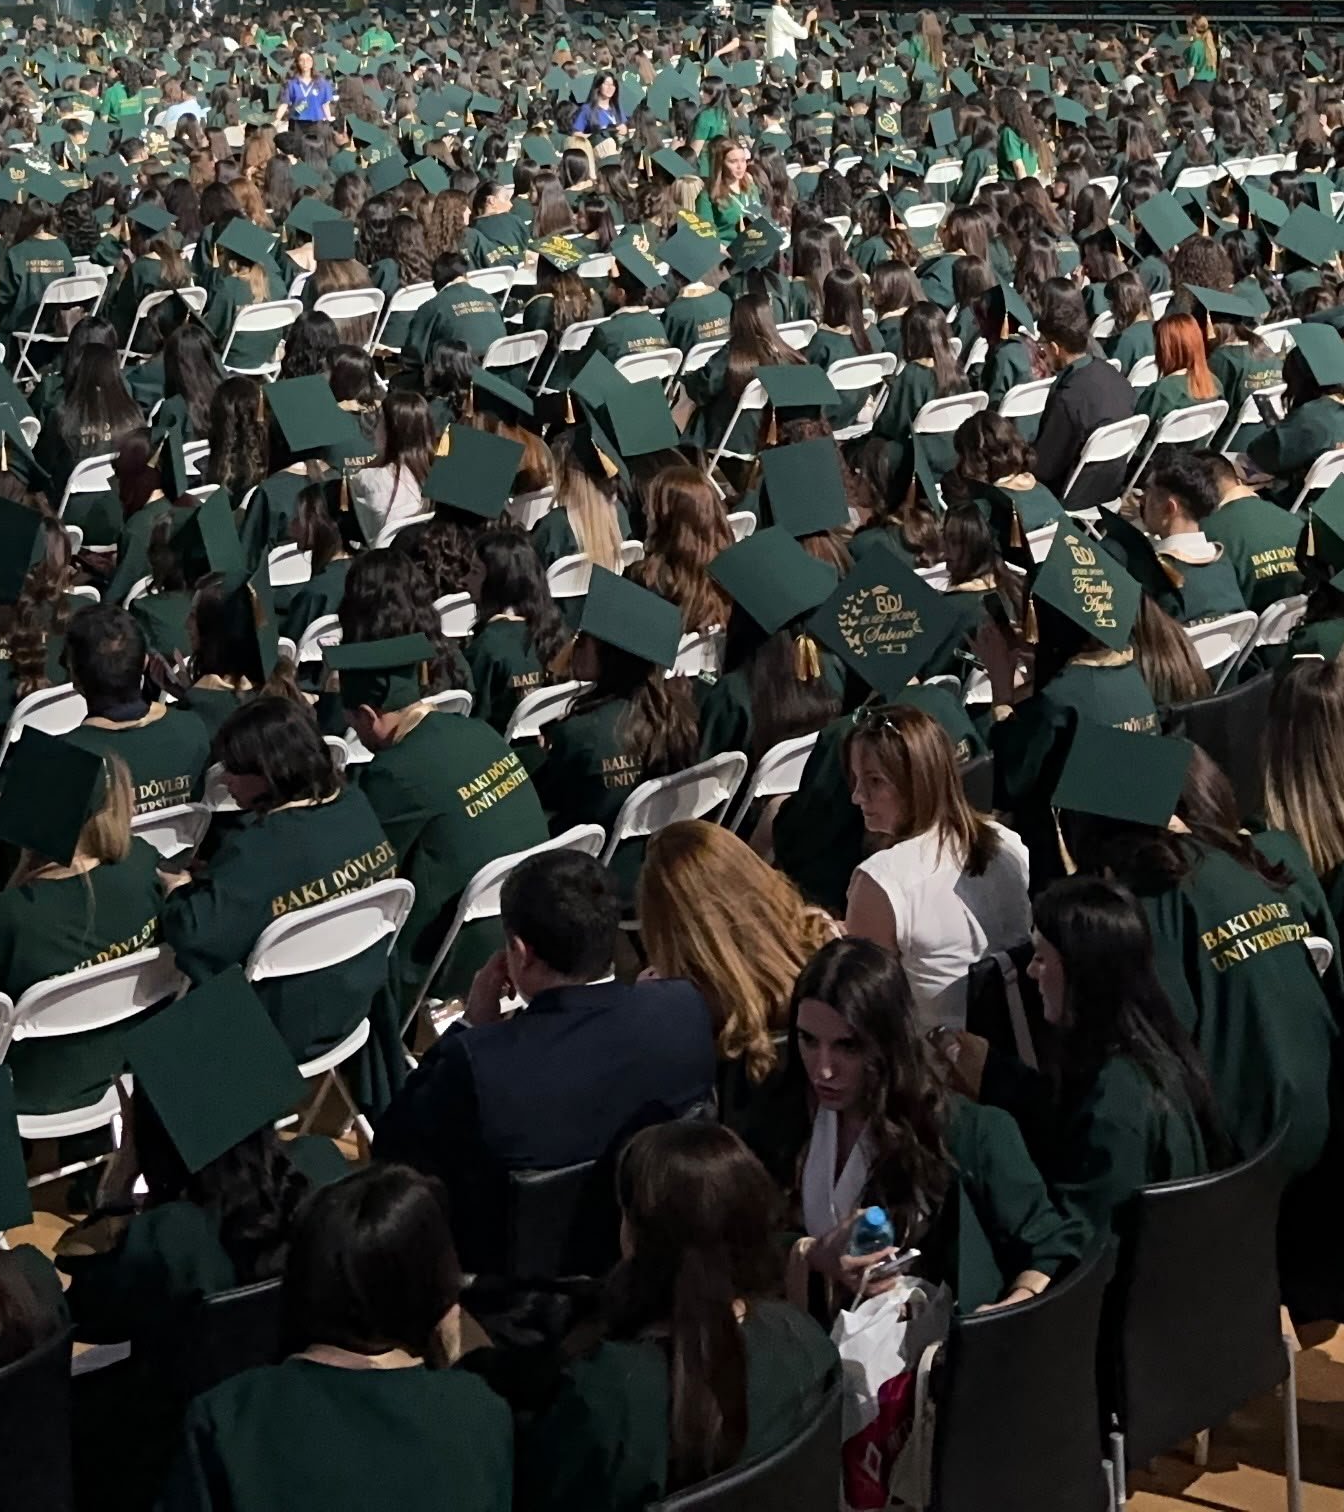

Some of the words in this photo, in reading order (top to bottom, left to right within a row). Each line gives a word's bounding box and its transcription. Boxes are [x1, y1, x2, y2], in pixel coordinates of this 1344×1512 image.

[1073, 576, 1114, 600] Finally
[512, 671, 539, 688] BAKI
[139, 774, 193, 800] DÖVLƏT
[457, 776, 490, 801] BAKI
[271, 879, 329, 917] BAKI
[331, 840, 397, 887] DÖVLƏT
[1201, 913, 1252, 951] BAKI
